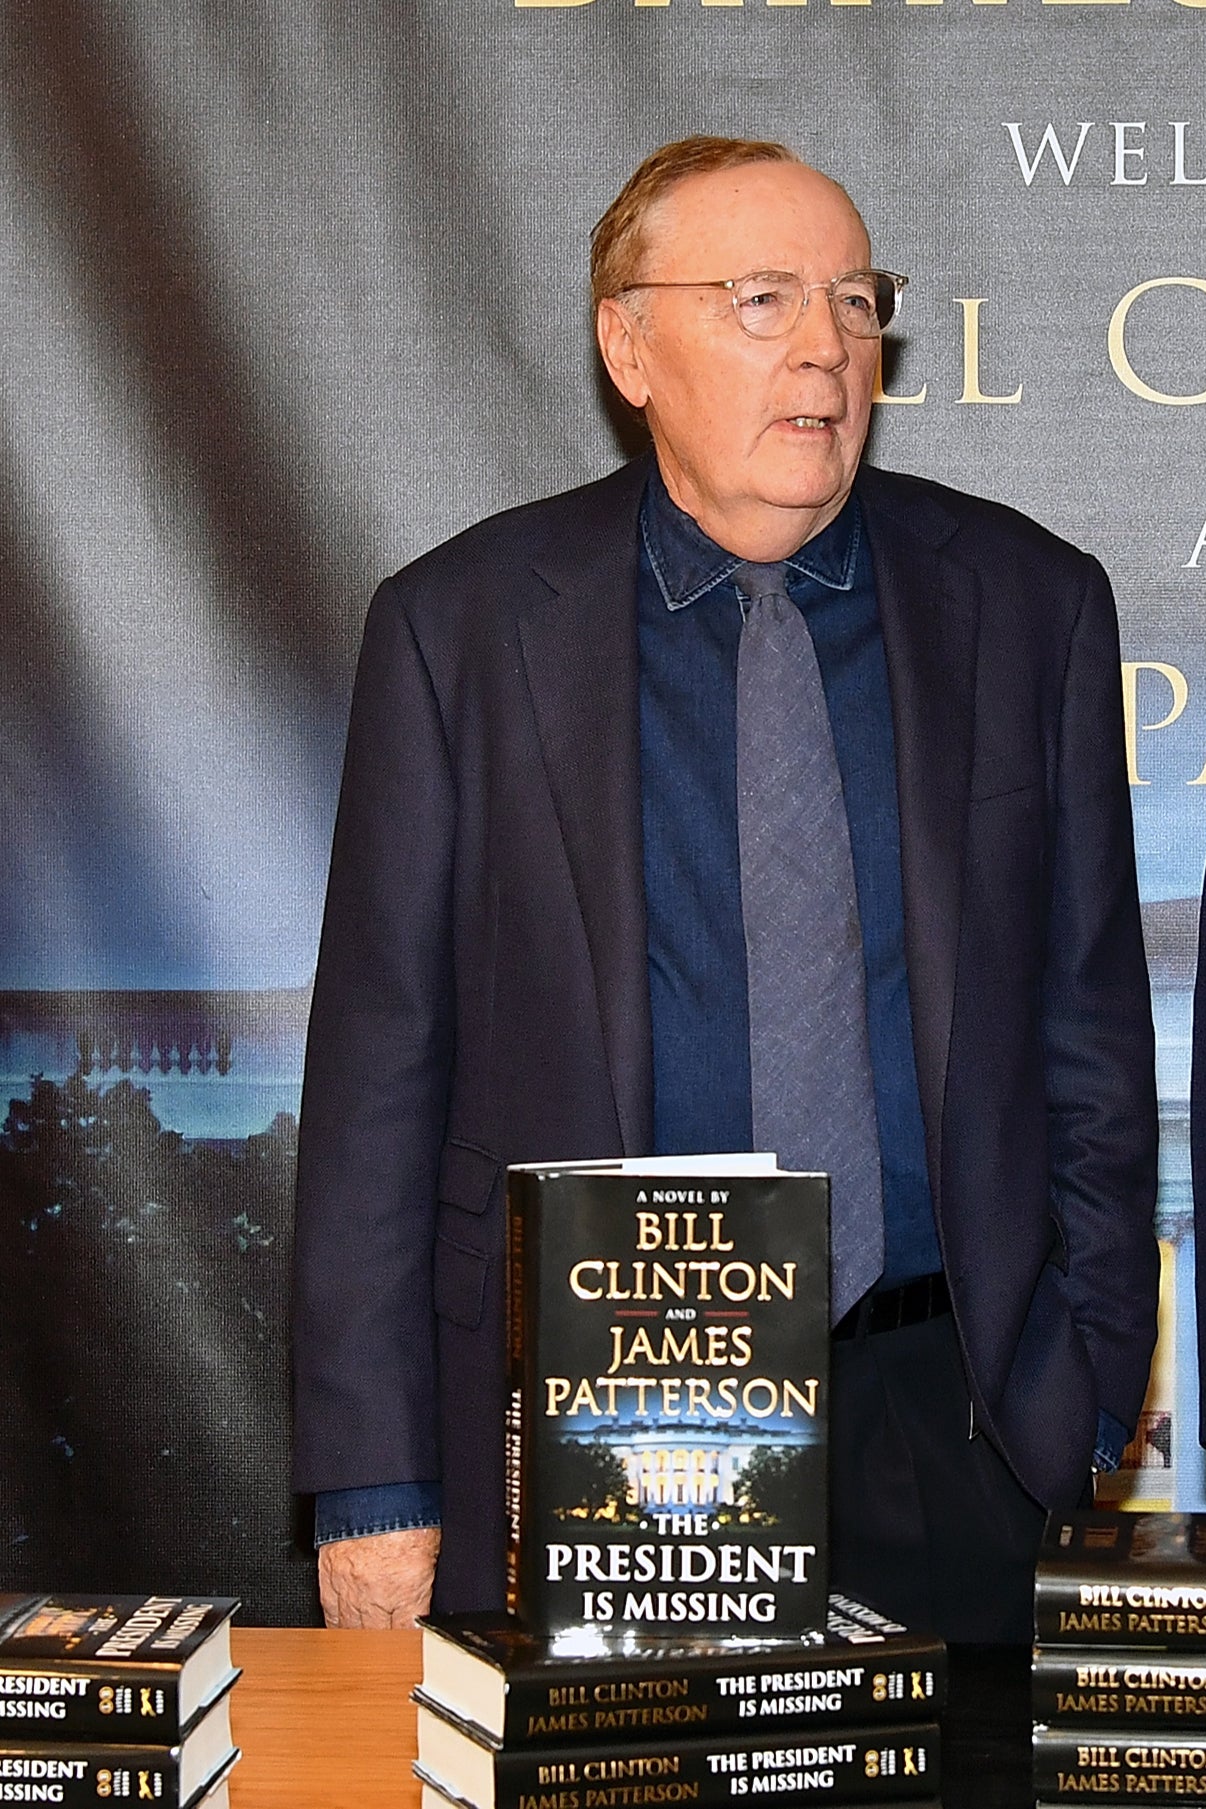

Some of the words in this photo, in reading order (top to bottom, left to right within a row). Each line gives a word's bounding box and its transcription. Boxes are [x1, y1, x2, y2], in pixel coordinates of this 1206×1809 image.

[636, 1191, 648, 1203] A
[652, 1191, 705, 1204] NOVEL
[711, 1190, 730, 1203] BY
[636, 1211, 735, 1251] BILL
[568, 1261, 797, 1301] CLINTON
[664, 1308, 697, 1321] AND
[607, 1325, 753, 1375] JAMES
[544, 1377, 819, 1419] PATTERSON
[653, 1513, 709, 1536] THE
[545, 1544, 816, 1584] PRESIDENT
[582, 1591, 615, 1622] IS
[622, 1591, 777, 1623] MISSING
[1079, 1585, 1123, 1607] BILL
[95, 1596, 183, 1657] PRESIDENT
[1059, 1611, 1122, 1633] JAMES
[716, 1675, 756, 1696] THE
[760, 1667, 865, 1693] PRESIDENT
[1076, 1666, 1120, 1688] BILL
[548, 1686, 589, 1707] BILL
[593, 1678, 689, 1703] CLINTON
[738, 1699, 757, 1718] IS
[759, 1693, 842, 1716] MISSING
[1056, 1692, 1119, 1713] JAMES
[527, 1712, 588, 1737] JAMES
[594, 1704, 708, 1729] PATTERSON
[0, 1759, 88, 1779] ESIDENT
[538, 1763, 581, 1785] BILL
[583, 1755, 680, 1782] CLINTON
[706, 1752, 748, 1774] THE
[751, 1744, 857, 1770] PRESIDENT
[1077, 1746, 1121, 1768] BILL
[585, 1781, 700, 1808] PATTERSON
[730, 1776, 748, 1796] IS
[751, 1770, 834, 1794] MISSING
[1057, 1772, 1120, 1792] JAMES
